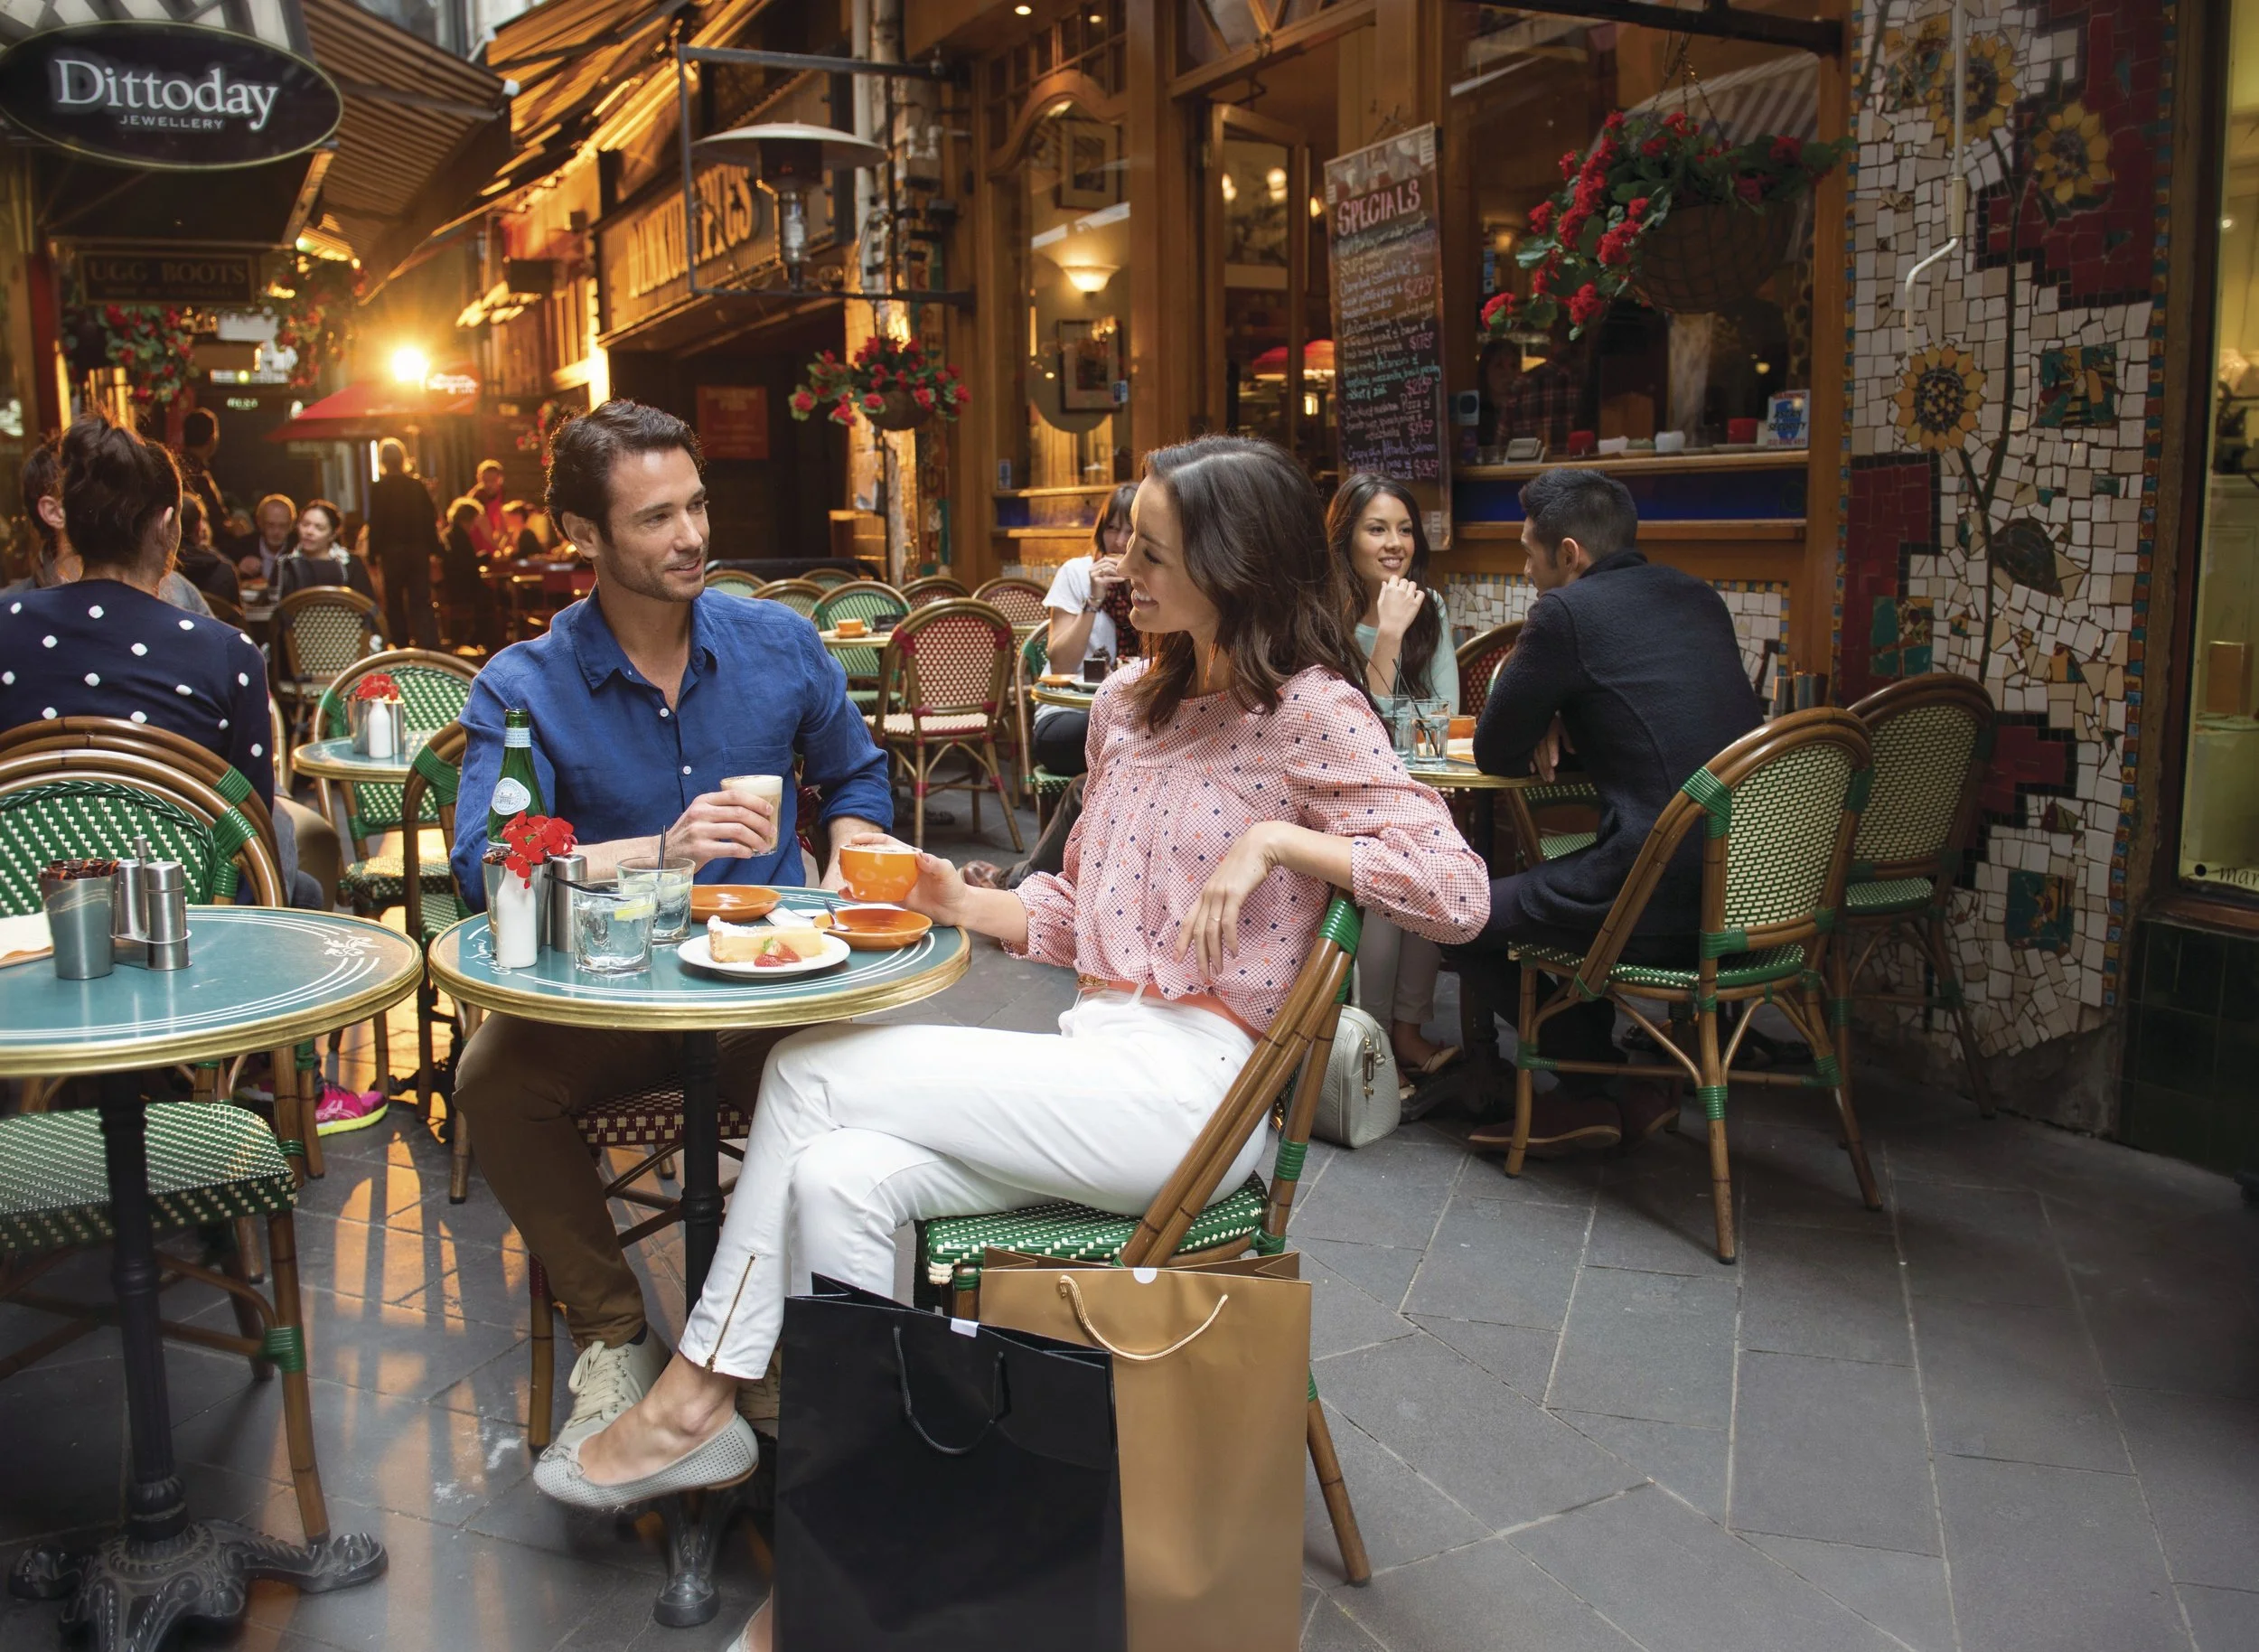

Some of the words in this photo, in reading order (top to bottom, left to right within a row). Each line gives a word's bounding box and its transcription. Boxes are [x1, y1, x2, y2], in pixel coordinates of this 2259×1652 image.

[54, 59, 279, 130] Dittoday
[119, 115, 225, 129] JEWELLERY
[1337, 179, 1421, 236] SPECIALS
[90, 260, 148, 282] UGG
[161, 262, 247, 284] BOOTS
